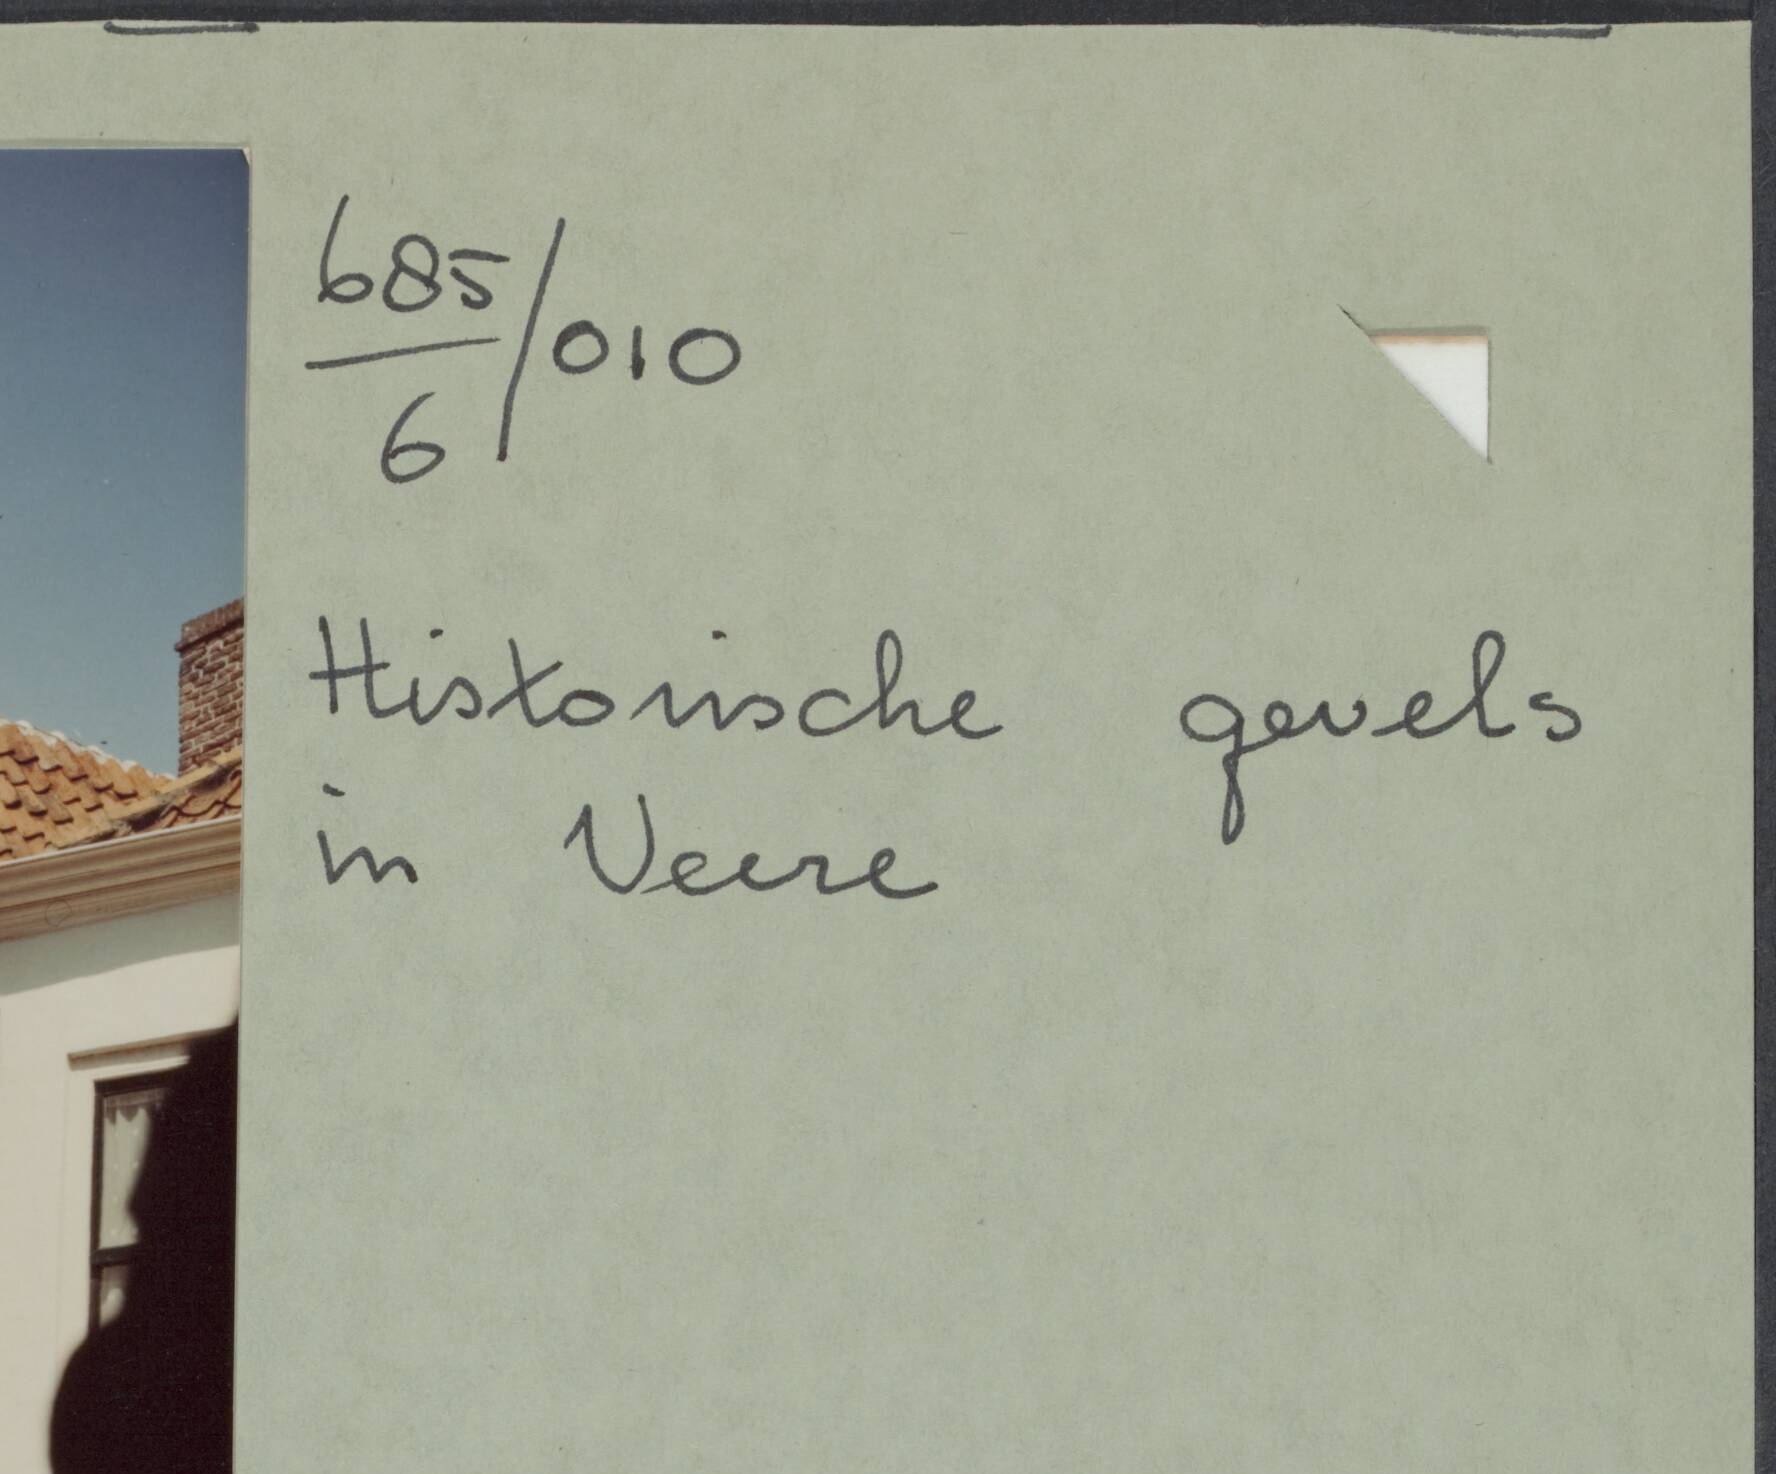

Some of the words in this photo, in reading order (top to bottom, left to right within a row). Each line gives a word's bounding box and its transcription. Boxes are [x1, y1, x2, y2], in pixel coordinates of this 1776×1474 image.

[307, 614, 1005, 742] Historische
[1178, 628, 1584, 848] gevels
[315, 782, 421, 888] in
[562, 792, 940, 902] Veere
